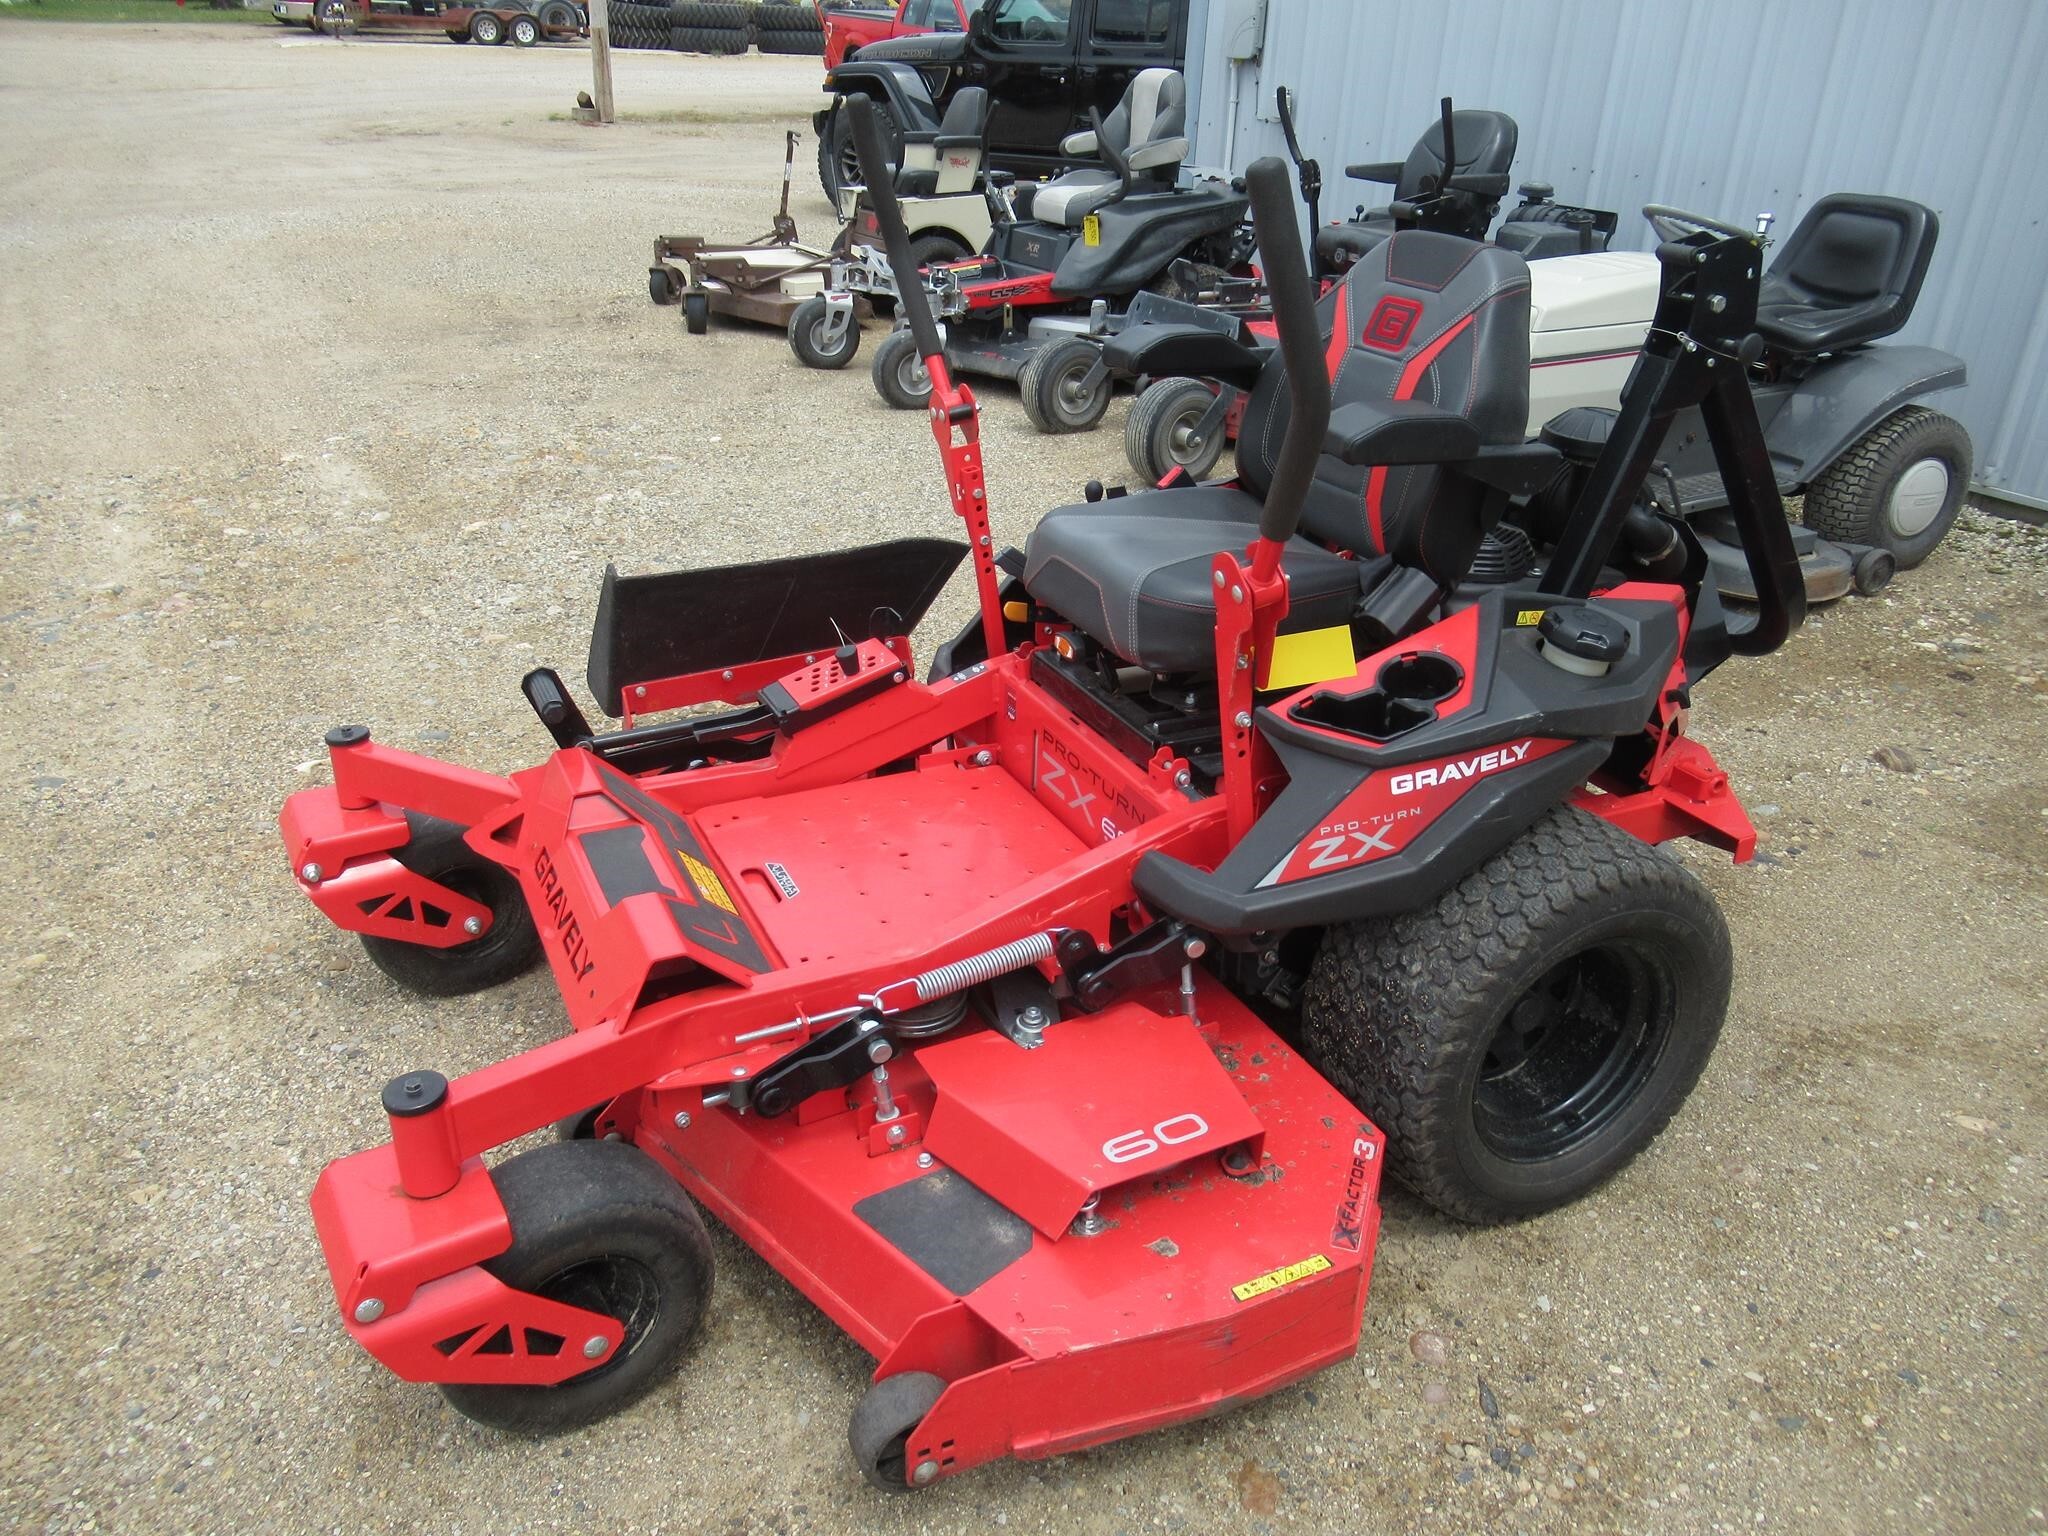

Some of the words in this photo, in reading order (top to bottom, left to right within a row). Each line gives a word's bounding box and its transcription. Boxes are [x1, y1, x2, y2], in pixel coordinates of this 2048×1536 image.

[1026, 242, 1040, 253] XR
[1040, 751, 1096, 829] ZX
[1042, 729, 1145, 825] PRO-TURN
[1390, 740, 1532, 796] GRAVELY
[1307, 823, 1397, 870] ZX
[1319, 806, 1421, 836] PRO-TURN
[534, 846, 595, 983] GRAVELY
[1102, 1113, 1208, 1163] 60
